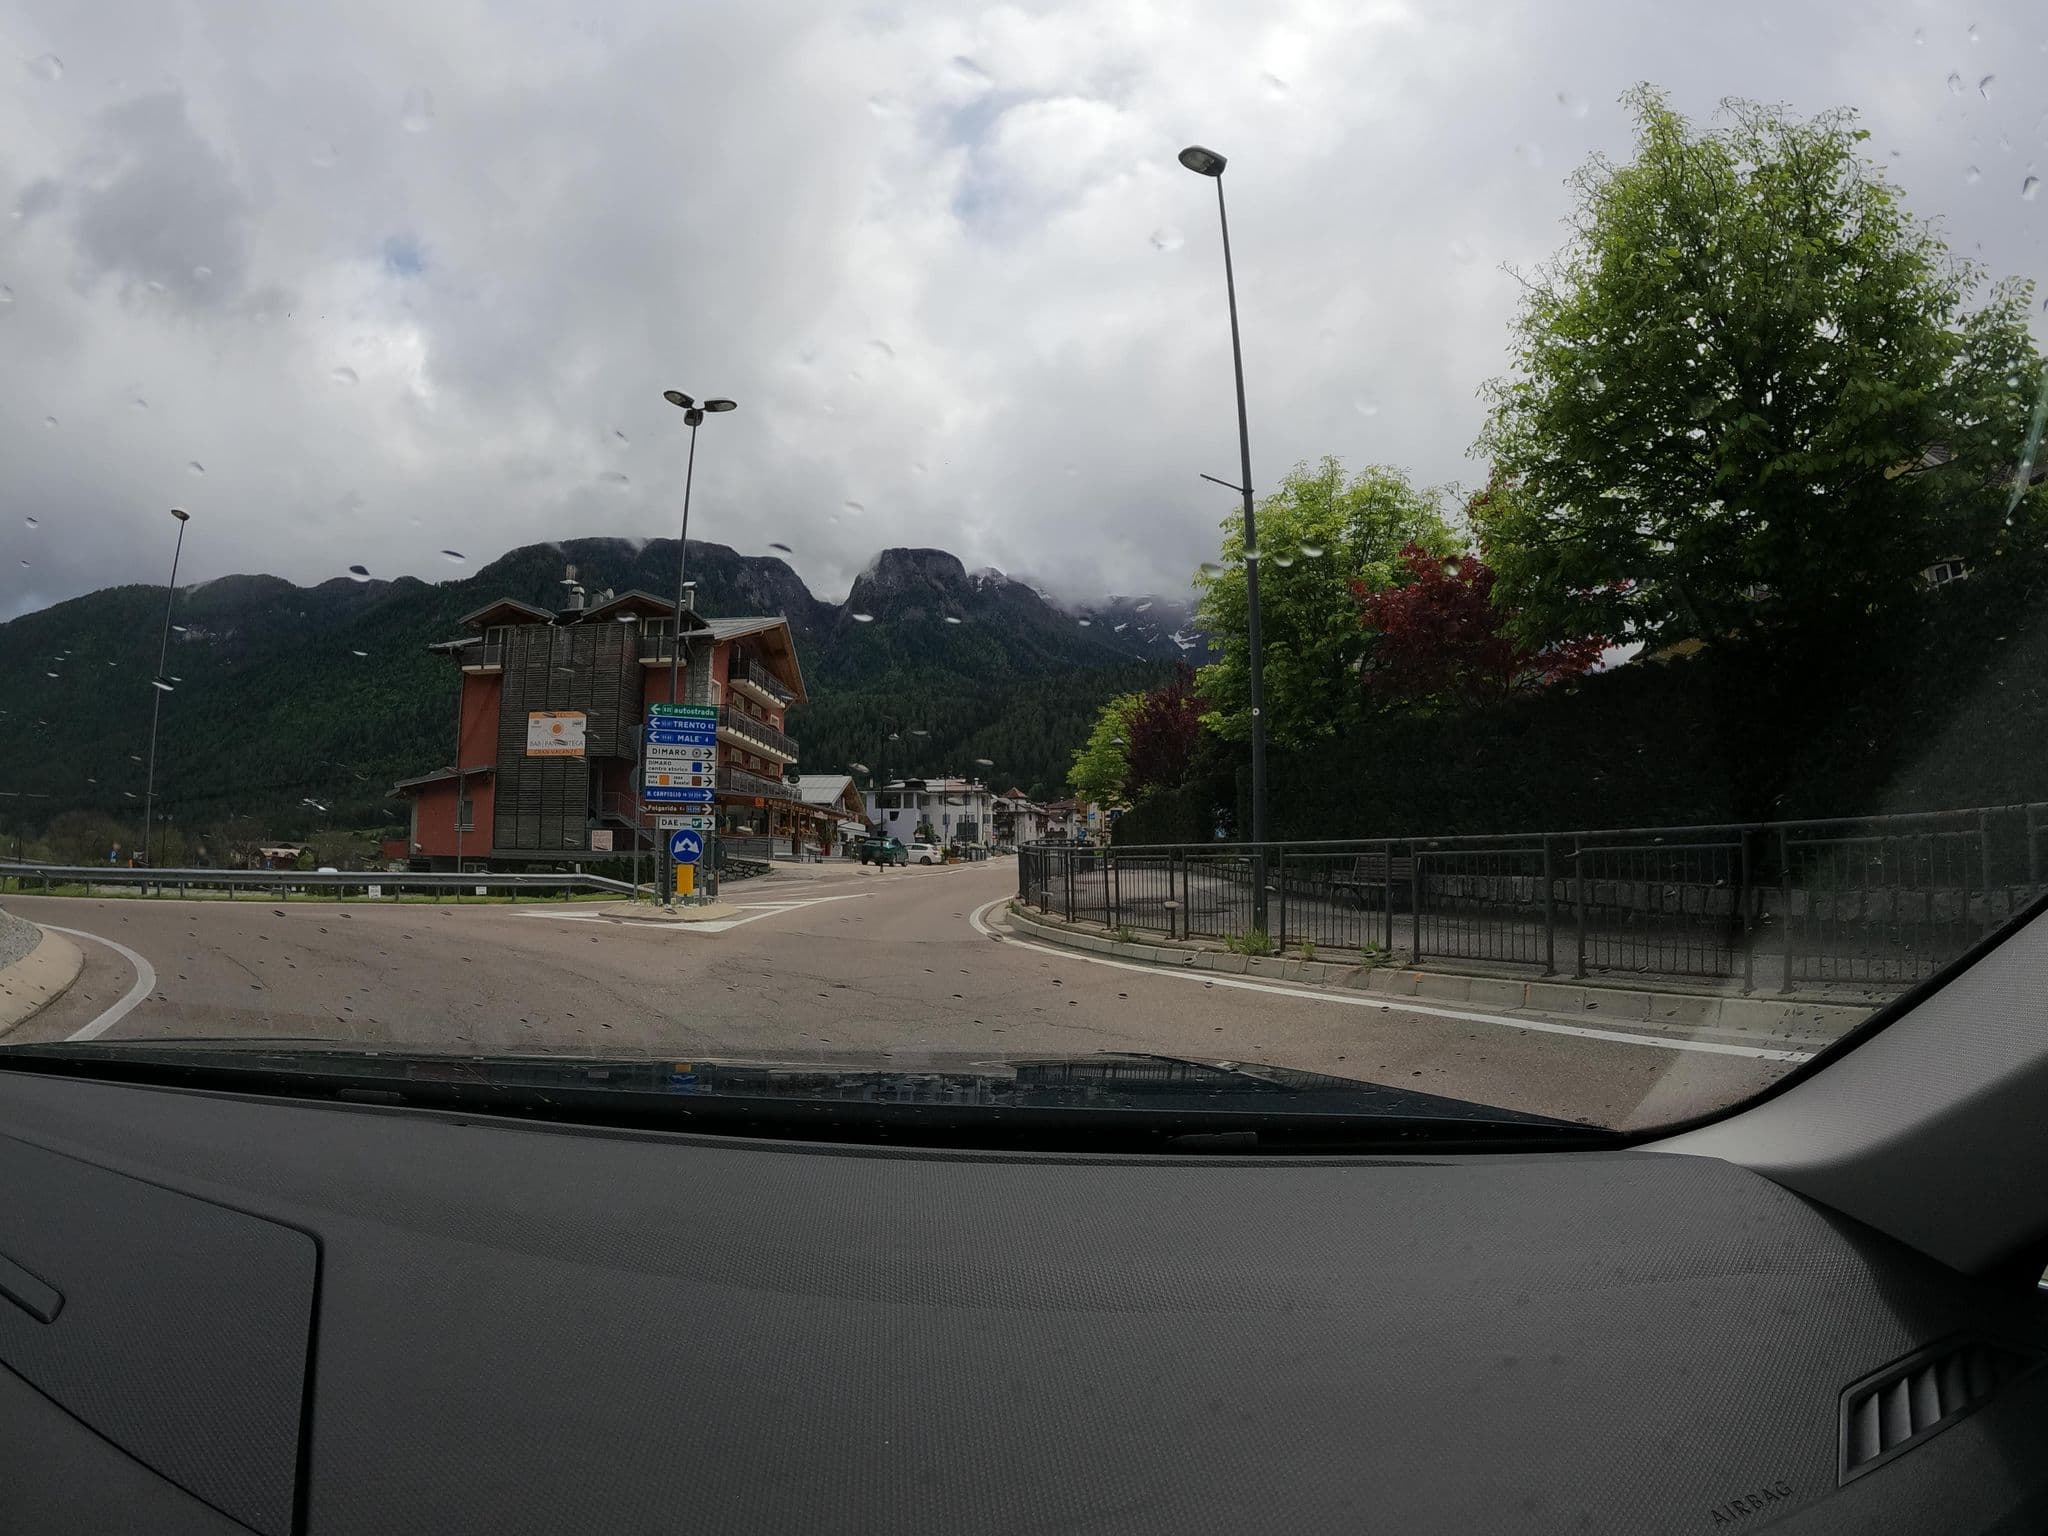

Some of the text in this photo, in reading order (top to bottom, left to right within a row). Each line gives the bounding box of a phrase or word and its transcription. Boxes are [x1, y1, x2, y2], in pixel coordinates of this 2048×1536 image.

[673, 708, 715, 716] autostrada
[673, 720, 706, 729] TRENTO
[652, 748, 687, 756] DIMARO
[647, 804, 677, 812] Folgarida
[1711, 1481, 1794, 1528] AIRBAG
